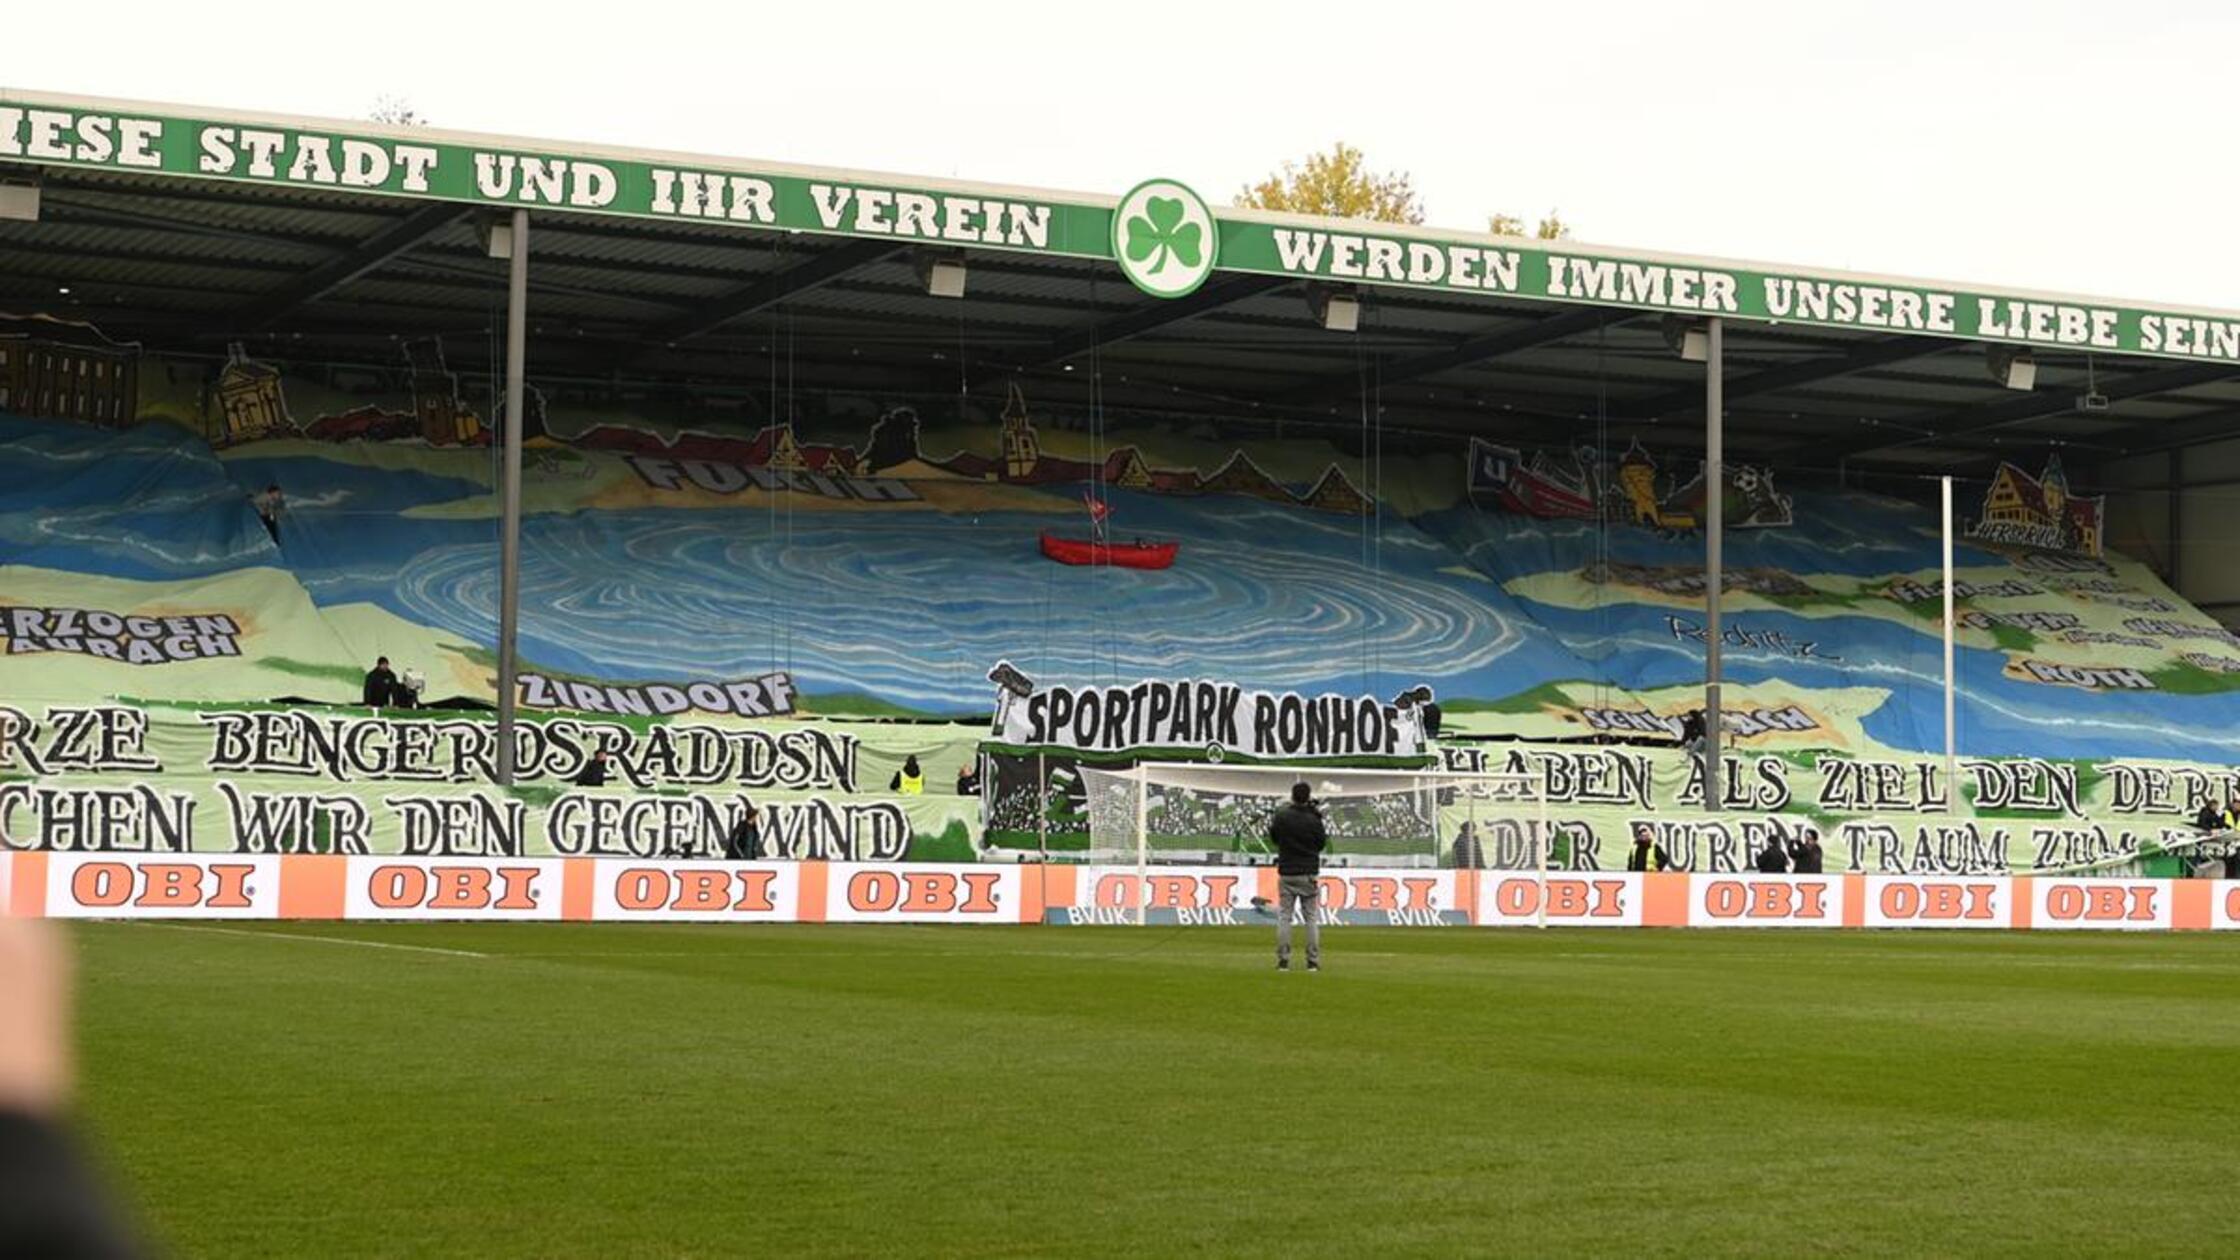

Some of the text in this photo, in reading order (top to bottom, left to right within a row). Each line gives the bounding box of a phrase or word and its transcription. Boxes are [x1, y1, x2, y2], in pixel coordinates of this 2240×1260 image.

[200, 126, 437, 192] STADT
[474, 152, 617, 208] UND
[651, 168, 776, 224] IHR
[810, 184, 1051, 248] VEREIN
[1273, 229, 1521, 293] WERDEN
[1546, 256, 1738, 314] IMMER
[1763, 276, 1956, 333] UNSERE
[1978, 299, 2119, 349] LIEBE
[2139, 317, 2240, 360] SEIN
[0, 608, 241, 638] RZOGEN
[8, 634, 243, 664] AURACH
[516, 672, 796, 716] ZIRNDORF
[2026, 660, 2157, 690] ROTH
[1026, 681, 1400, 754] SPORTPARK RONHOF
[1582, 706, 1820, 740] SCHWACH
[1440, 749, 1655, 810] HABEN
[1678, 751, 1790, 812] ALS
[1818, 757, 1948, 812] ZIEL
[1962, 760, 2090, 820] DEN
[218, 782, 371, 854] WIR
[391, 800, 527, 856] DEN
[548, 795, 912, 860] GEGENWIND
[1843, 822, 2010, 875] TRAUM
[72, 862, 255, 908] OBI
[369, 865, 540, 909] OBI
[615, 868, 777, 910] OBI
[847, 871, 1000, 912] OBI
[1096, 874, 1239, 909] OBI
[1496, 878, 1625, 917] OBI
[1705, 881, 1827, 919] OBI
[1880, 882, 1996, 920] OBI
[2046, 885, 2157, 921] OBI
